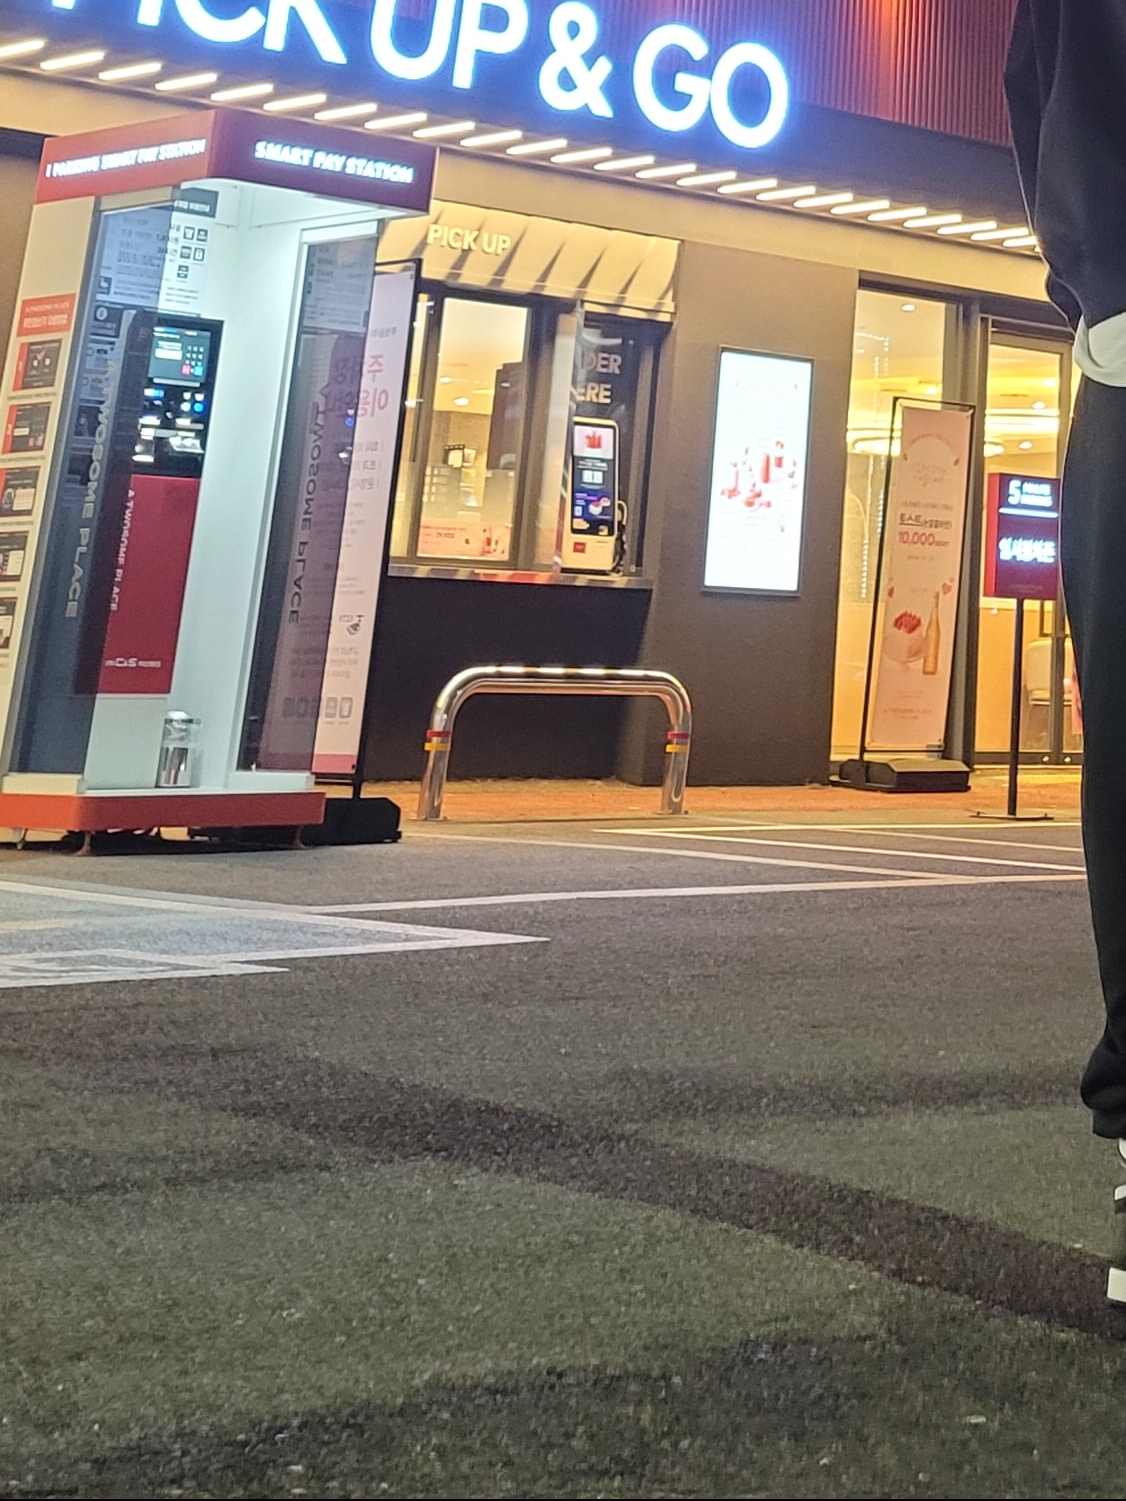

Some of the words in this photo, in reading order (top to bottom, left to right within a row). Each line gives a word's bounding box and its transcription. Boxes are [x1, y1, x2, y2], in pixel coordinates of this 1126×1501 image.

[538, 0, 614, 118] &
[632, 23, 791, 149] GO
[254, 140, 314, 167] SMART
[312, 150, 346, 172] PAY
[345, 156, 414, 184] STATION
[427, 224, 479, 251] PICK
[482, 232, 511, 255] UP
[582, 350, 622, 375] DER
[1008, 479, 1021, 505] 5
[65, 528, 91, 618] PLACE
